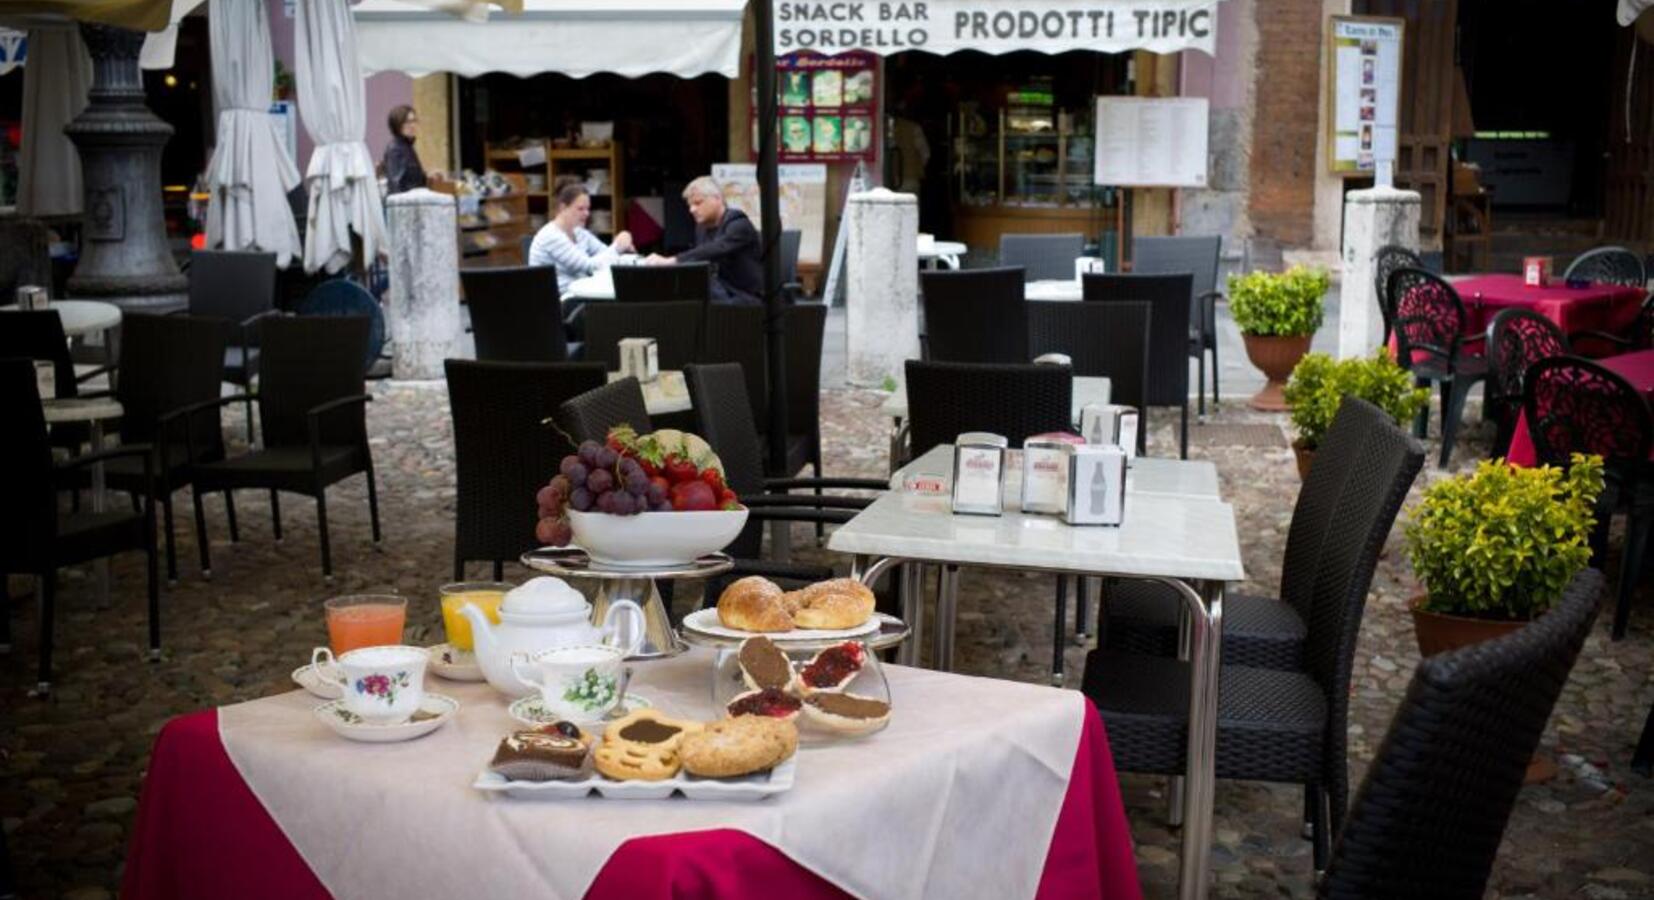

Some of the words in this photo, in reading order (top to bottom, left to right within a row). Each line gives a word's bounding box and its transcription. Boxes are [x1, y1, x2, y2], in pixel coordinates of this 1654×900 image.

[779, 2, 864, 21] SNACK
[878, 2, 929, 21] BAR
[954, 10, 1114, 39] PRODOTTI
[1132, 9, 1210, 38] TIPIC
[779, 28, 928, 47] SORDELLO
